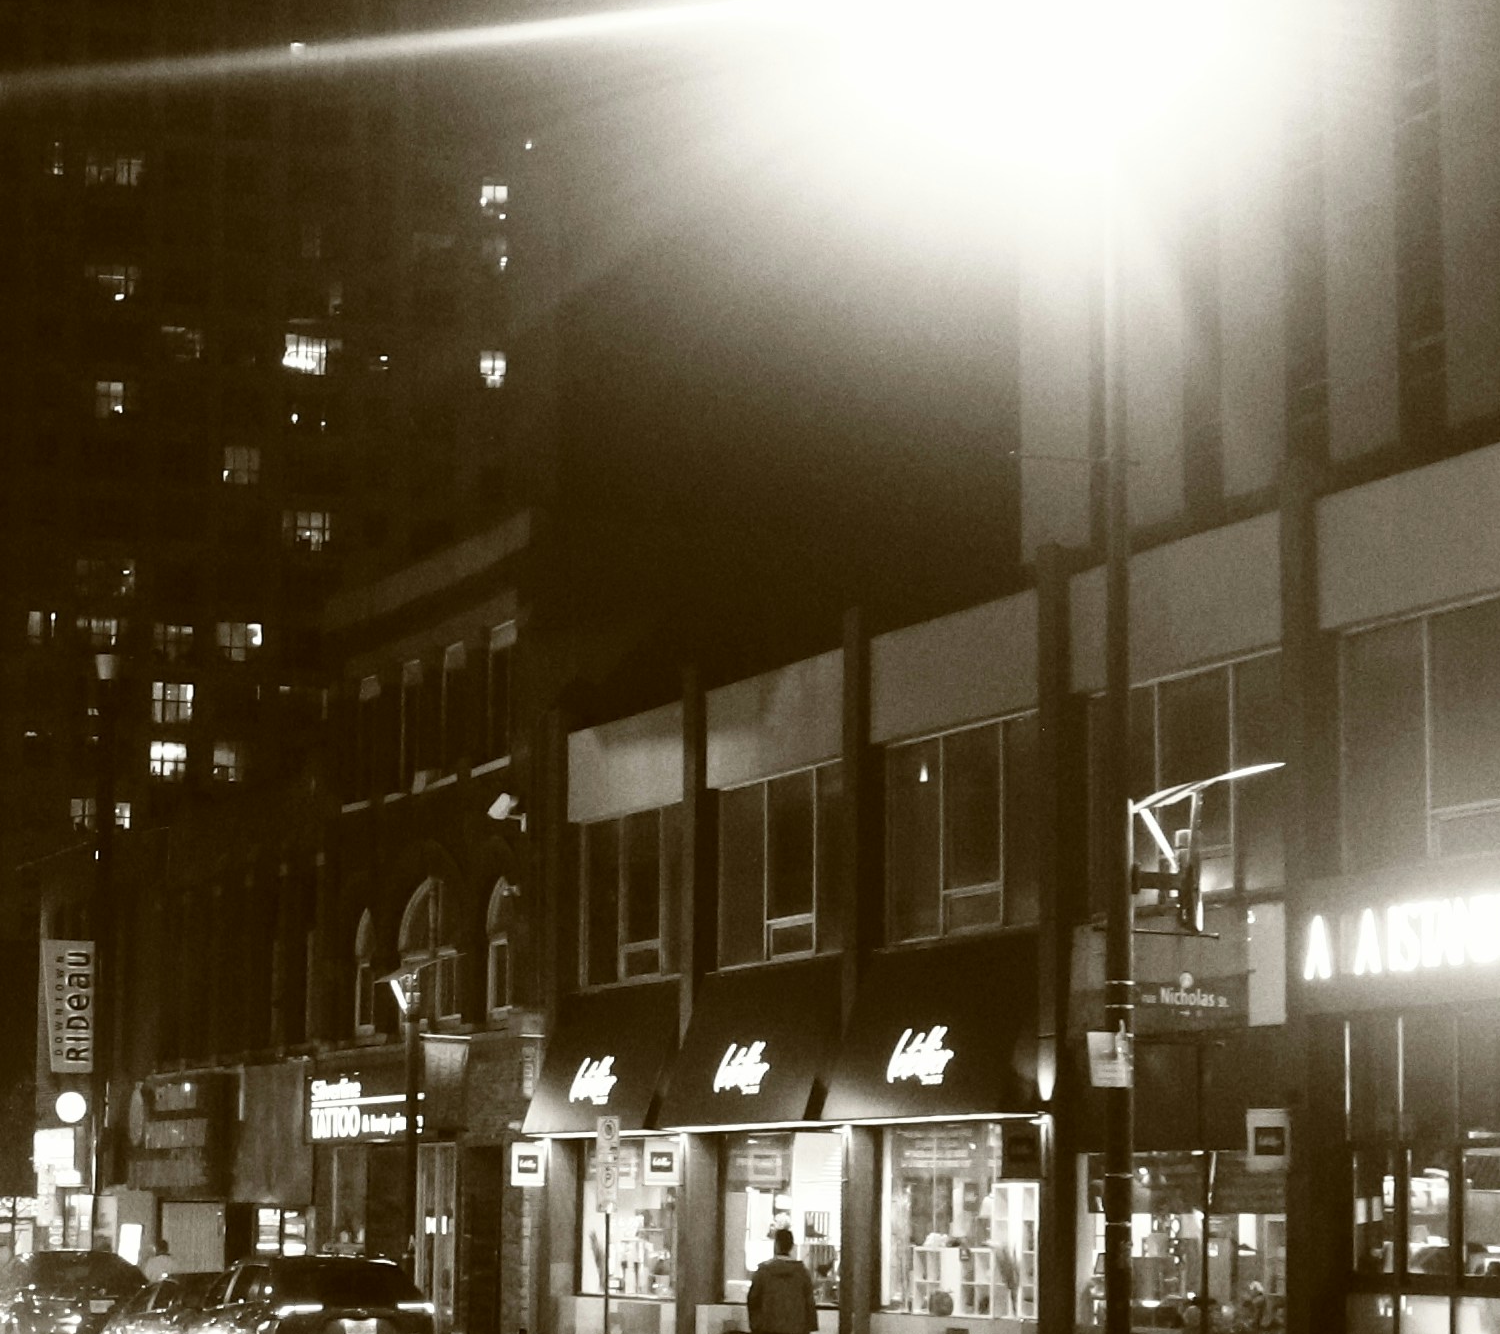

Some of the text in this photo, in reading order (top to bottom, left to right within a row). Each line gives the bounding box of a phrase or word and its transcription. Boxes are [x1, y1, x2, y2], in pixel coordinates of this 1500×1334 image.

[1303, 914, 1332, 981] A
[54, 955, 65, 1056] DOWNTOWN
[1159, 986, 1216, 1007] Nicholas
[310, 1105, 361, 1139] TATTOO
